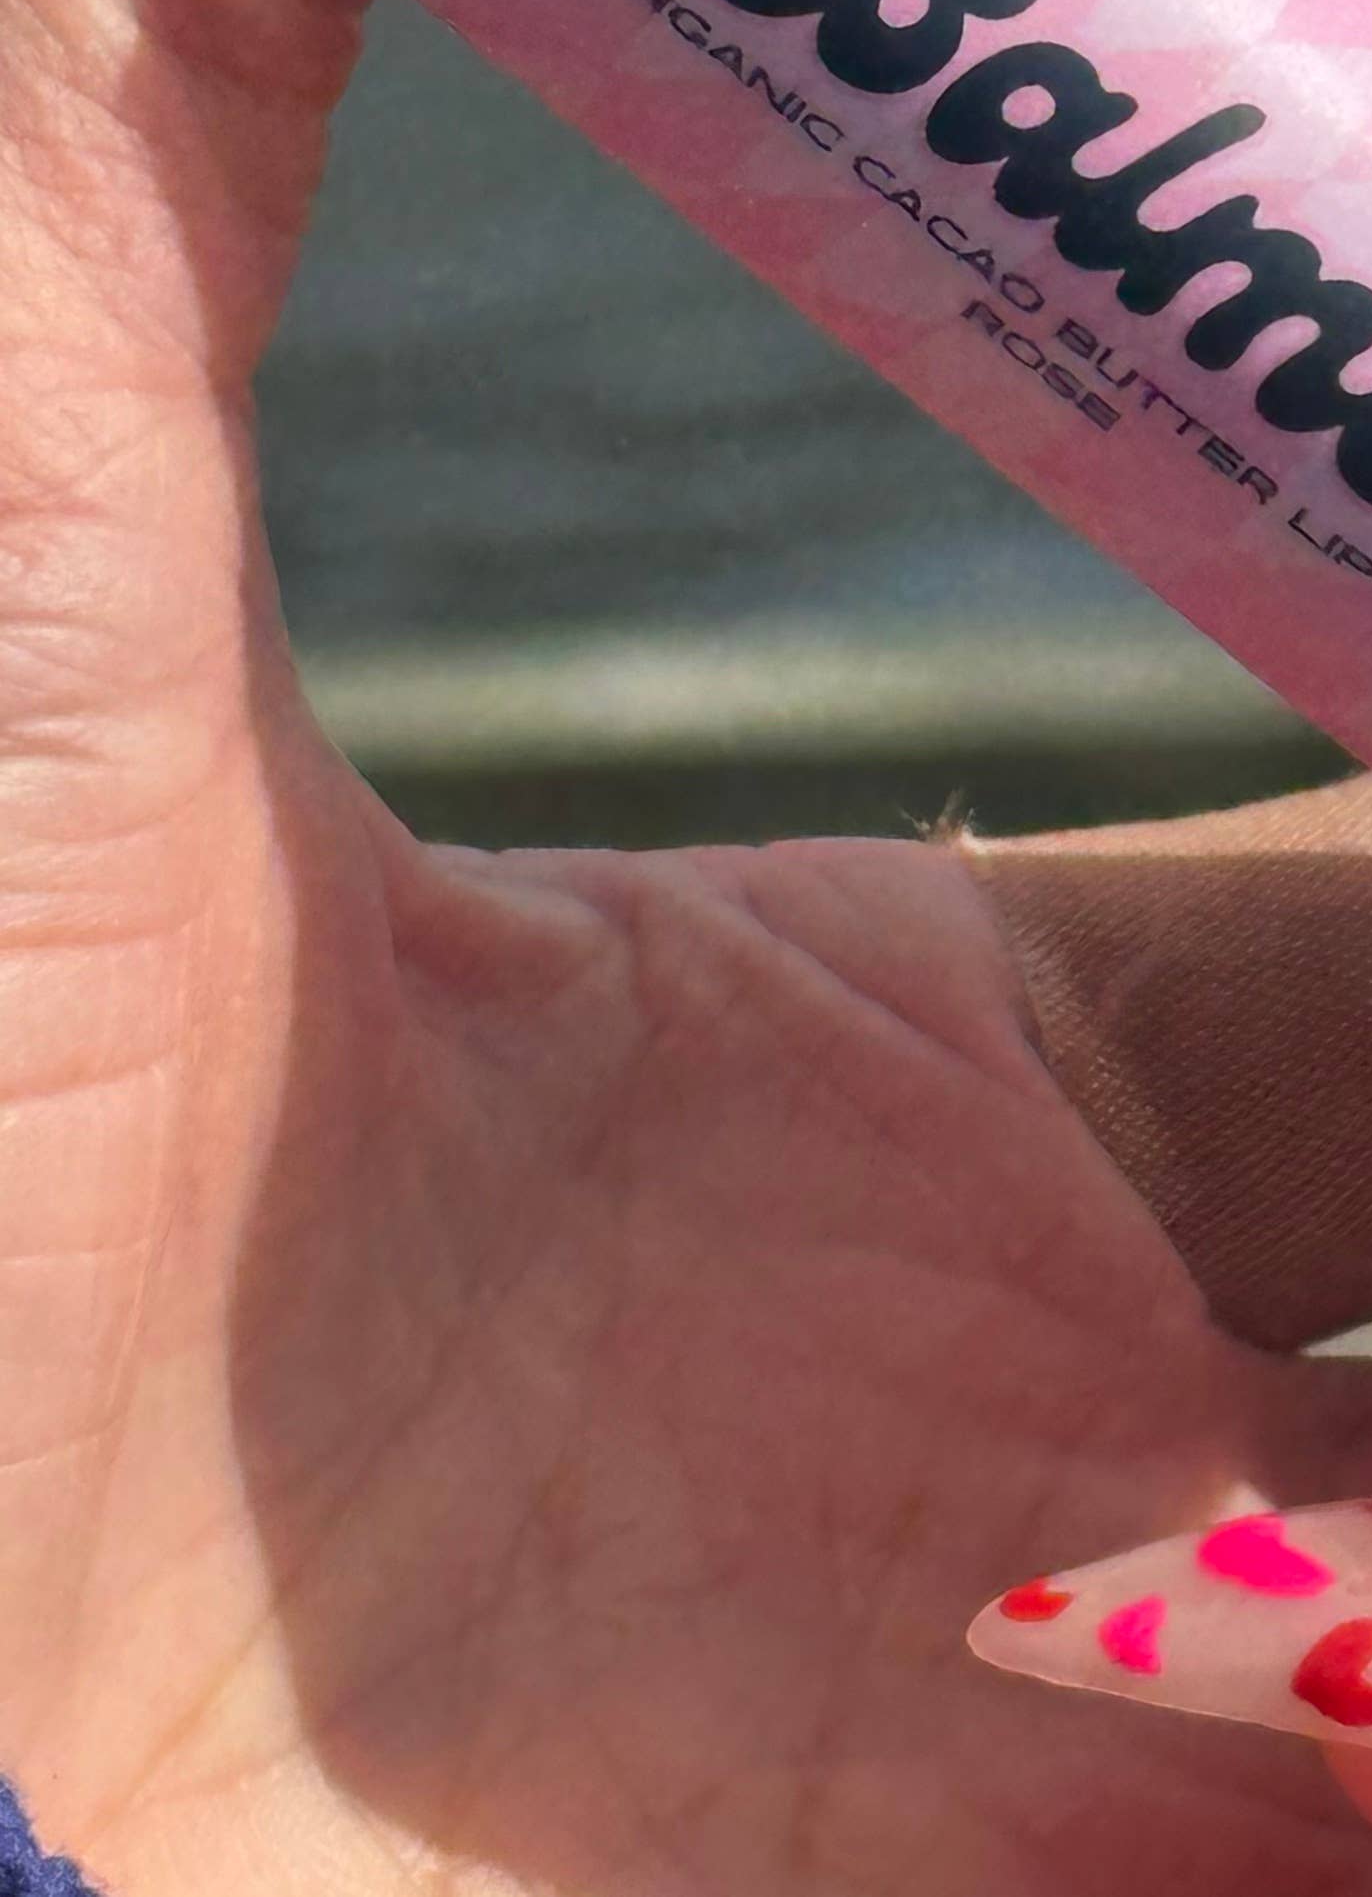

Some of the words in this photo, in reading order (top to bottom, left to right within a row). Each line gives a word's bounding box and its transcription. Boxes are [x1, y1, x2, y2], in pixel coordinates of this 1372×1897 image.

[853, 155, 1046, 314] CACAO
[1055, 317, 1280, 506] BUTTER
[961, 300, 1121, 432] ROSE
